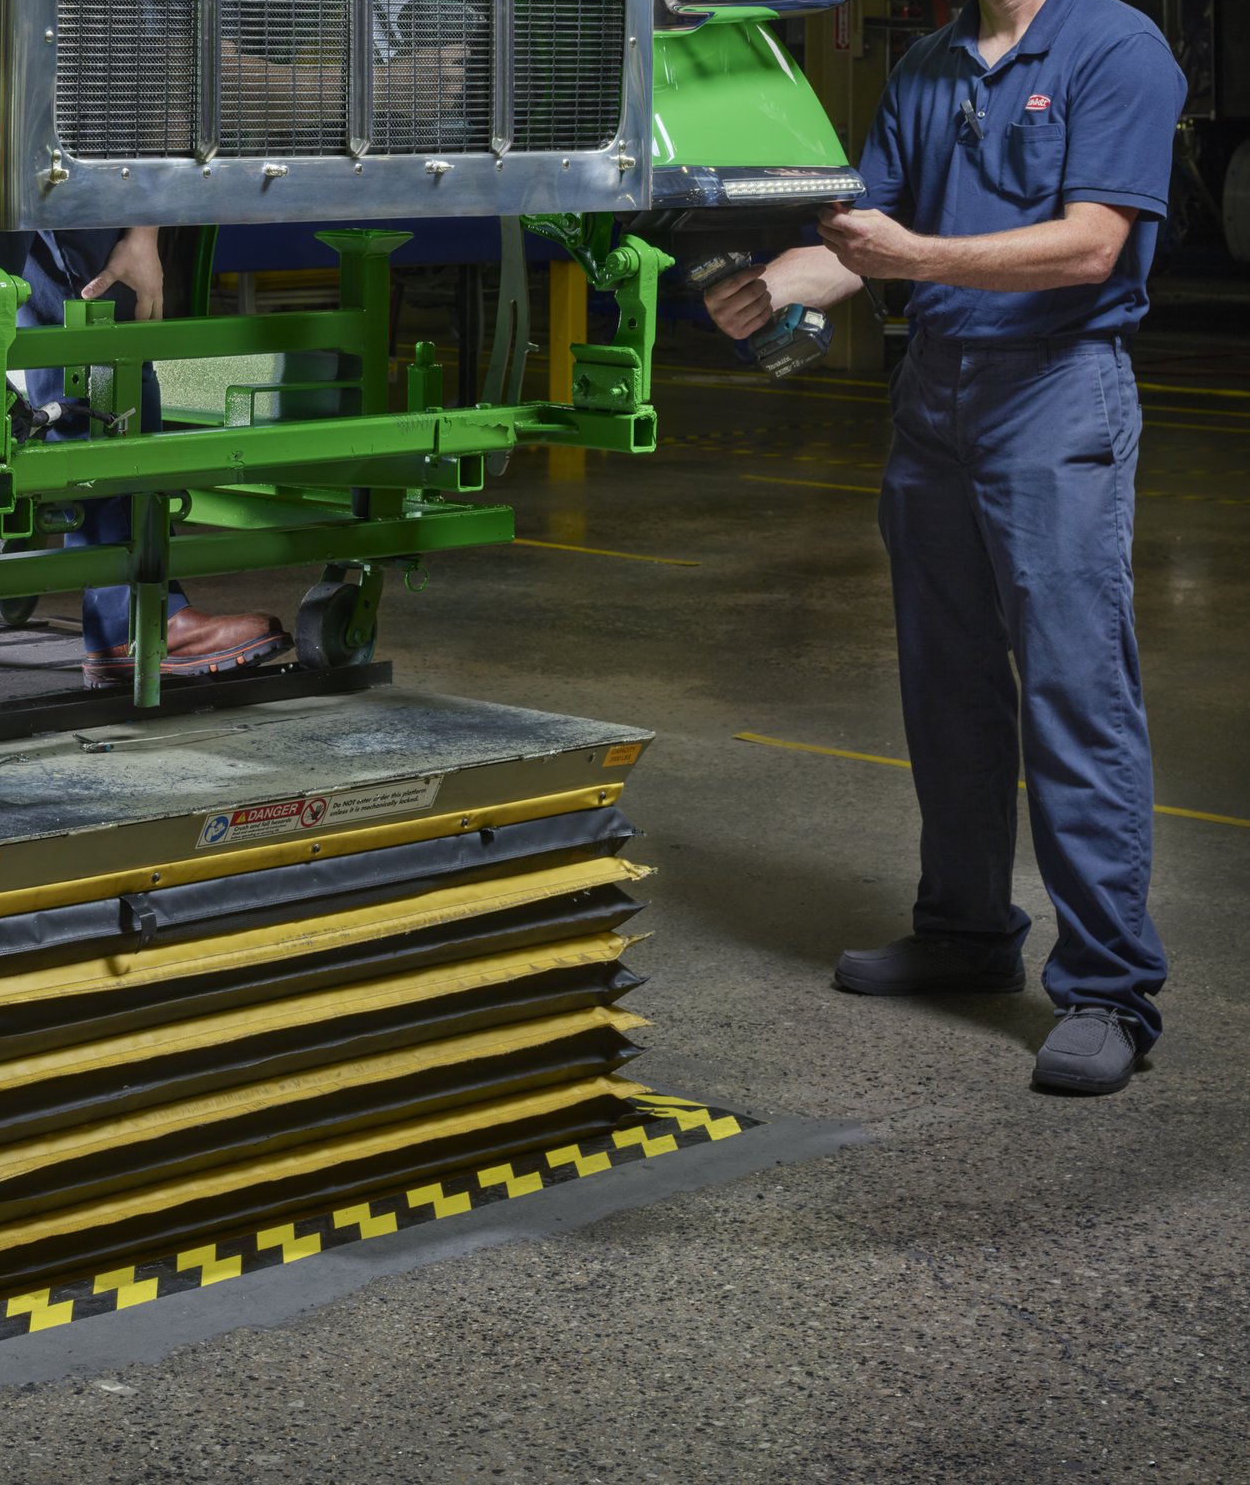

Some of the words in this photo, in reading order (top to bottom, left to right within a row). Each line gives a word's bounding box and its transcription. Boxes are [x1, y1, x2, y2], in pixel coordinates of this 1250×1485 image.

[343, 799, 357, 807] NOT
[356, 797, 372, 805] enter
[373, 794, 390, 803] under
[391, 791, 402, 799] this
[401, 787, 428, 799] platform
[247, 803, 299, 822] DANGER
[329, 808, 349, 817] unless
[360, 798, 398, 812] mechanically
